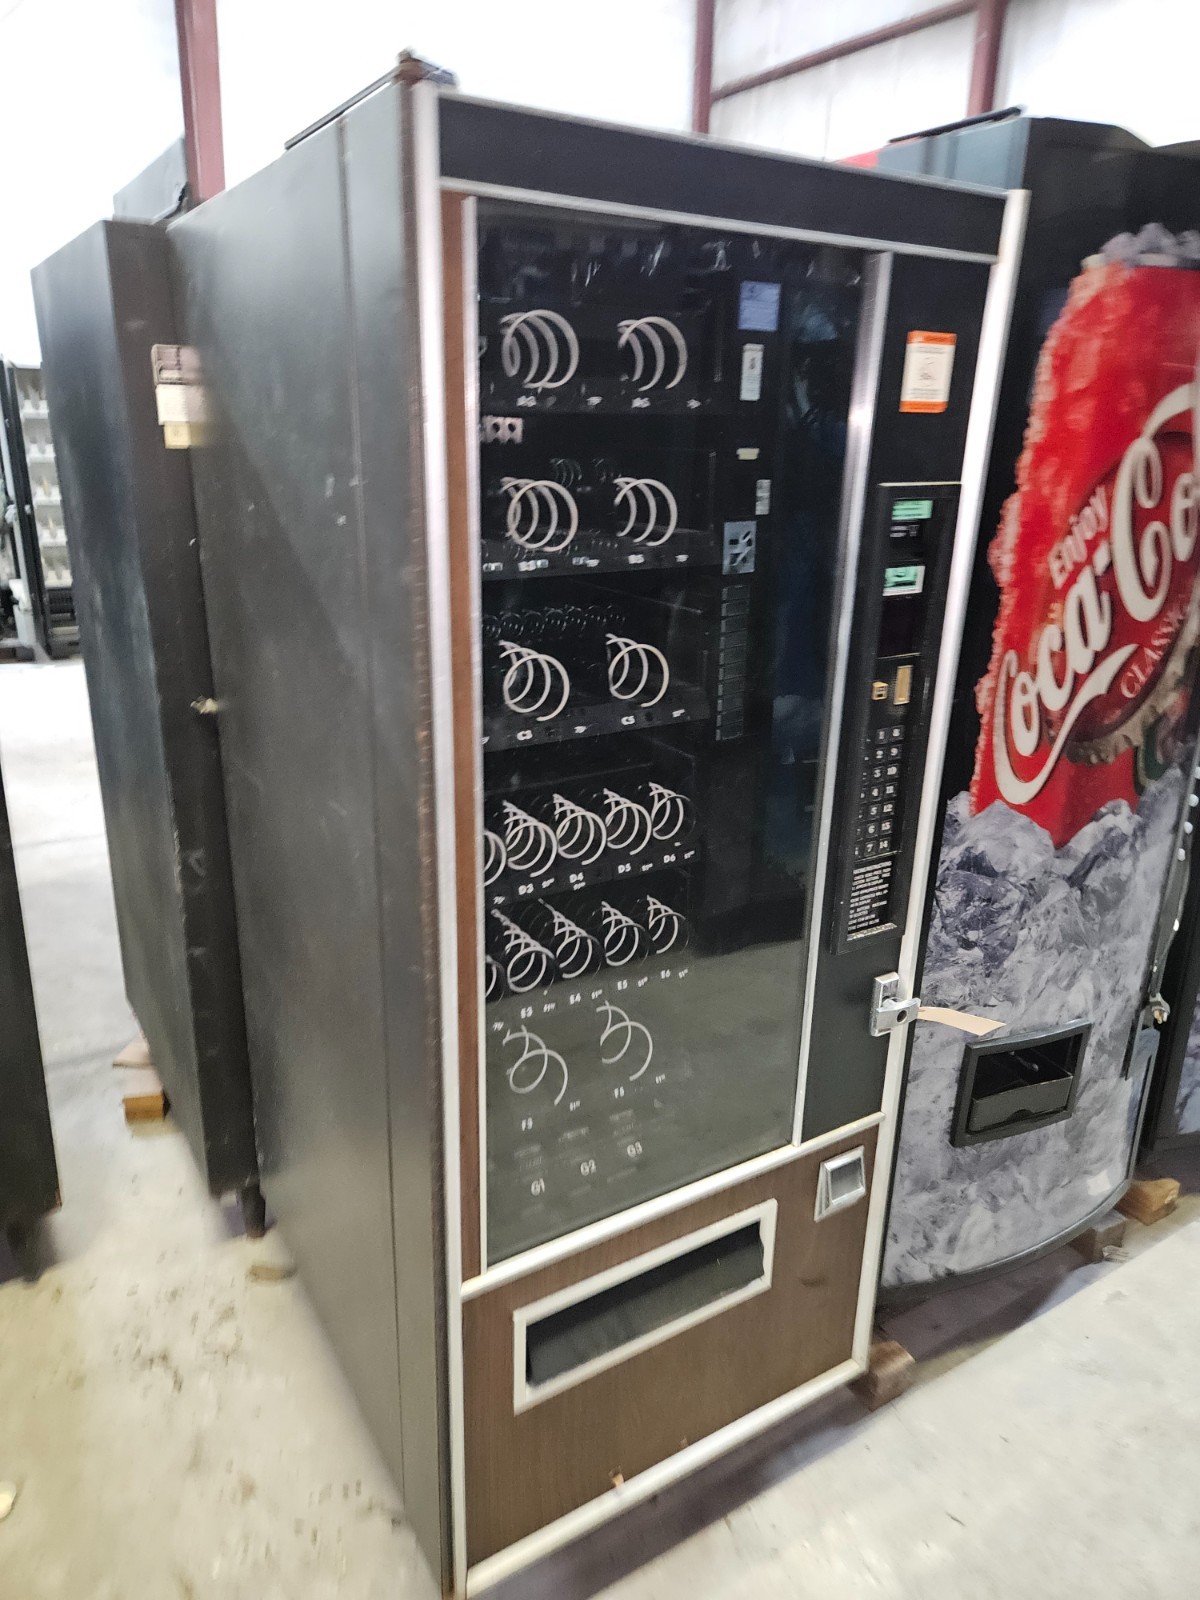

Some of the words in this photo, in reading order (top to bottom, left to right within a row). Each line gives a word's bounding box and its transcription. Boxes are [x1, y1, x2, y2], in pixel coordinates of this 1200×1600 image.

[663, 853, 677, 864] D6
[617, 862, 632, 874] D5
[580, 1159, 597, 1176] G2
[530, 1178, 546, 1197] G1
